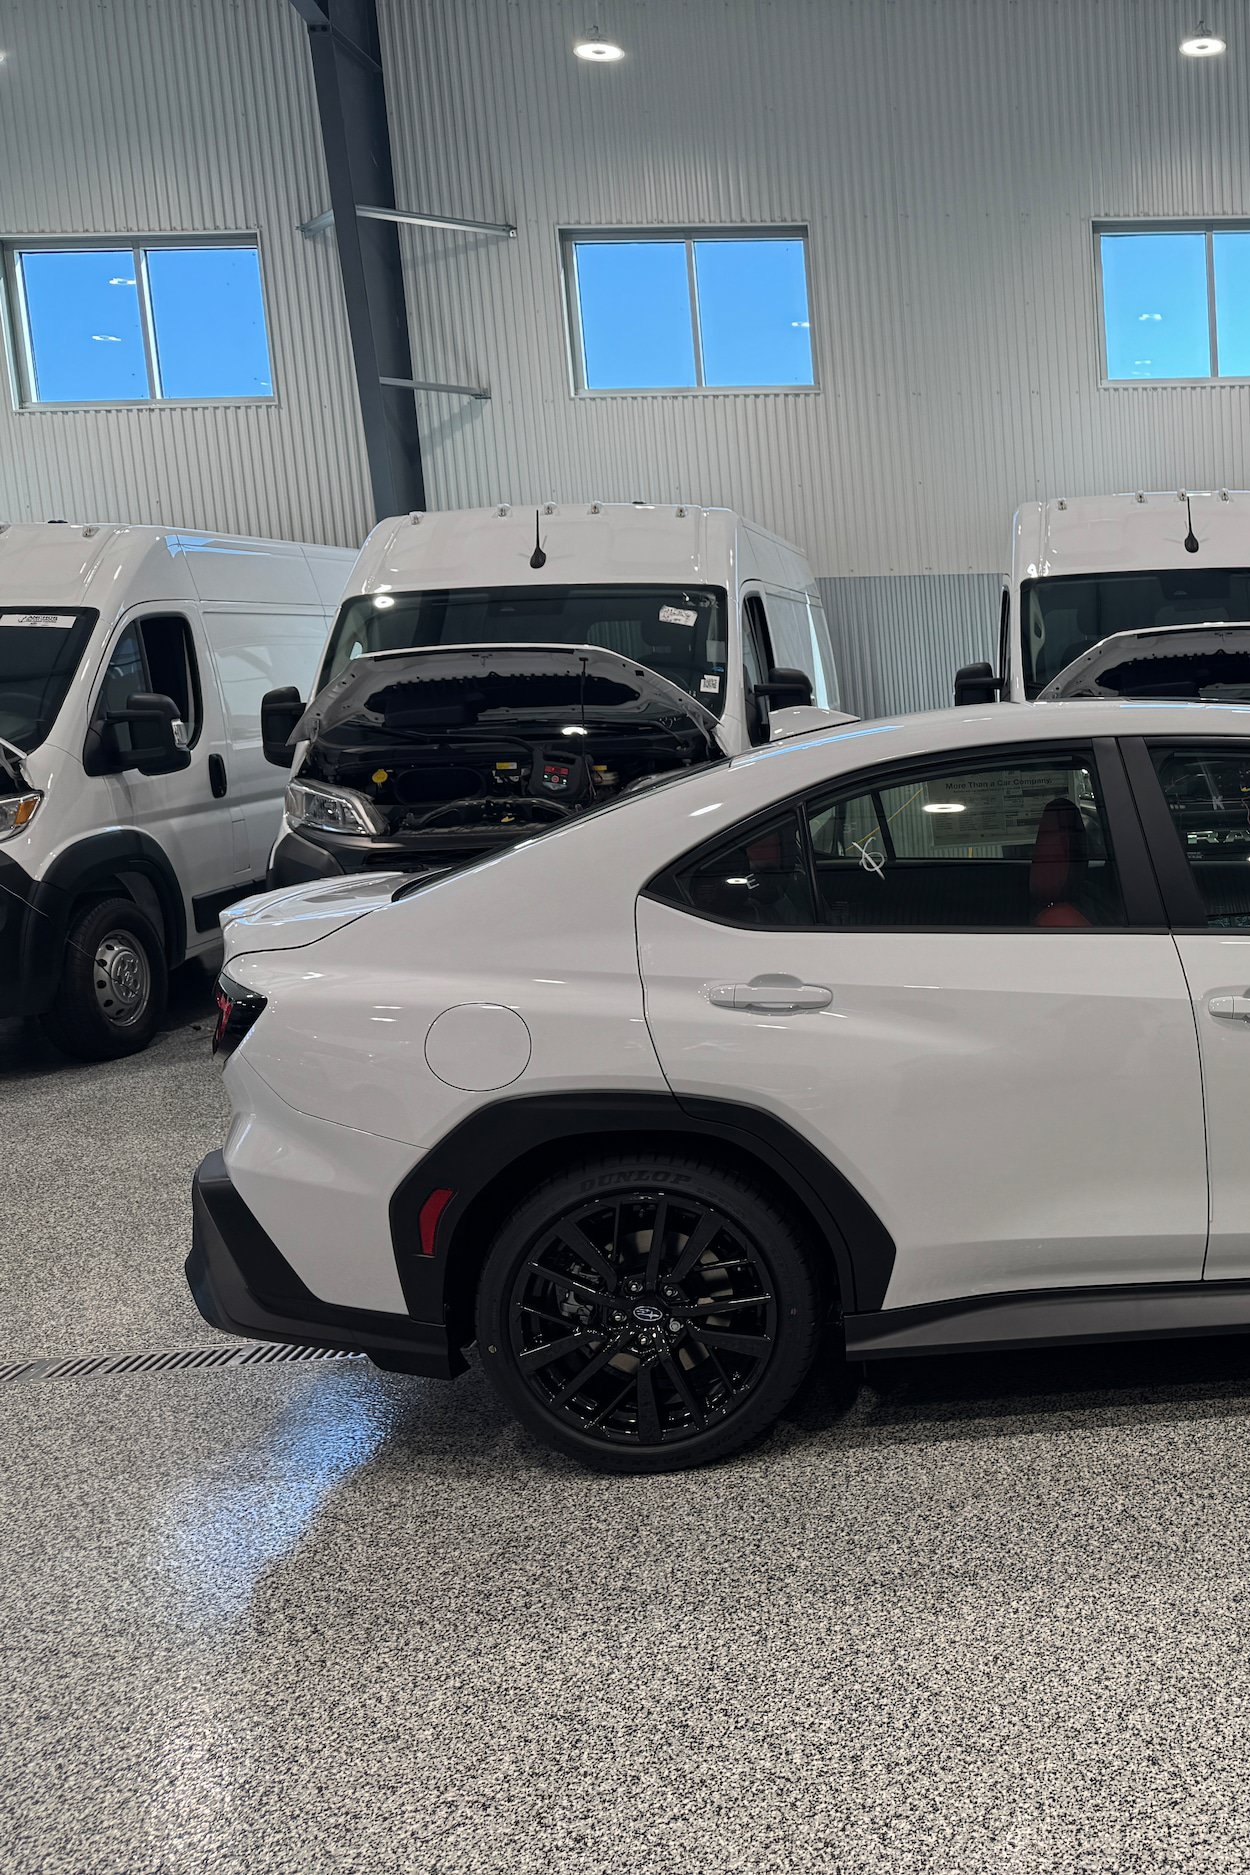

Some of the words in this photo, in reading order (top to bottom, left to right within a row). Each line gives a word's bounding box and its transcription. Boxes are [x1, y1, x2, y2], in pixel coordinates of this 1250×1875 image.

[945, 782, 966, 790] More
[968, 781, 988, 789] Than
[578, 1169, 692, 1194] DUNLOP
